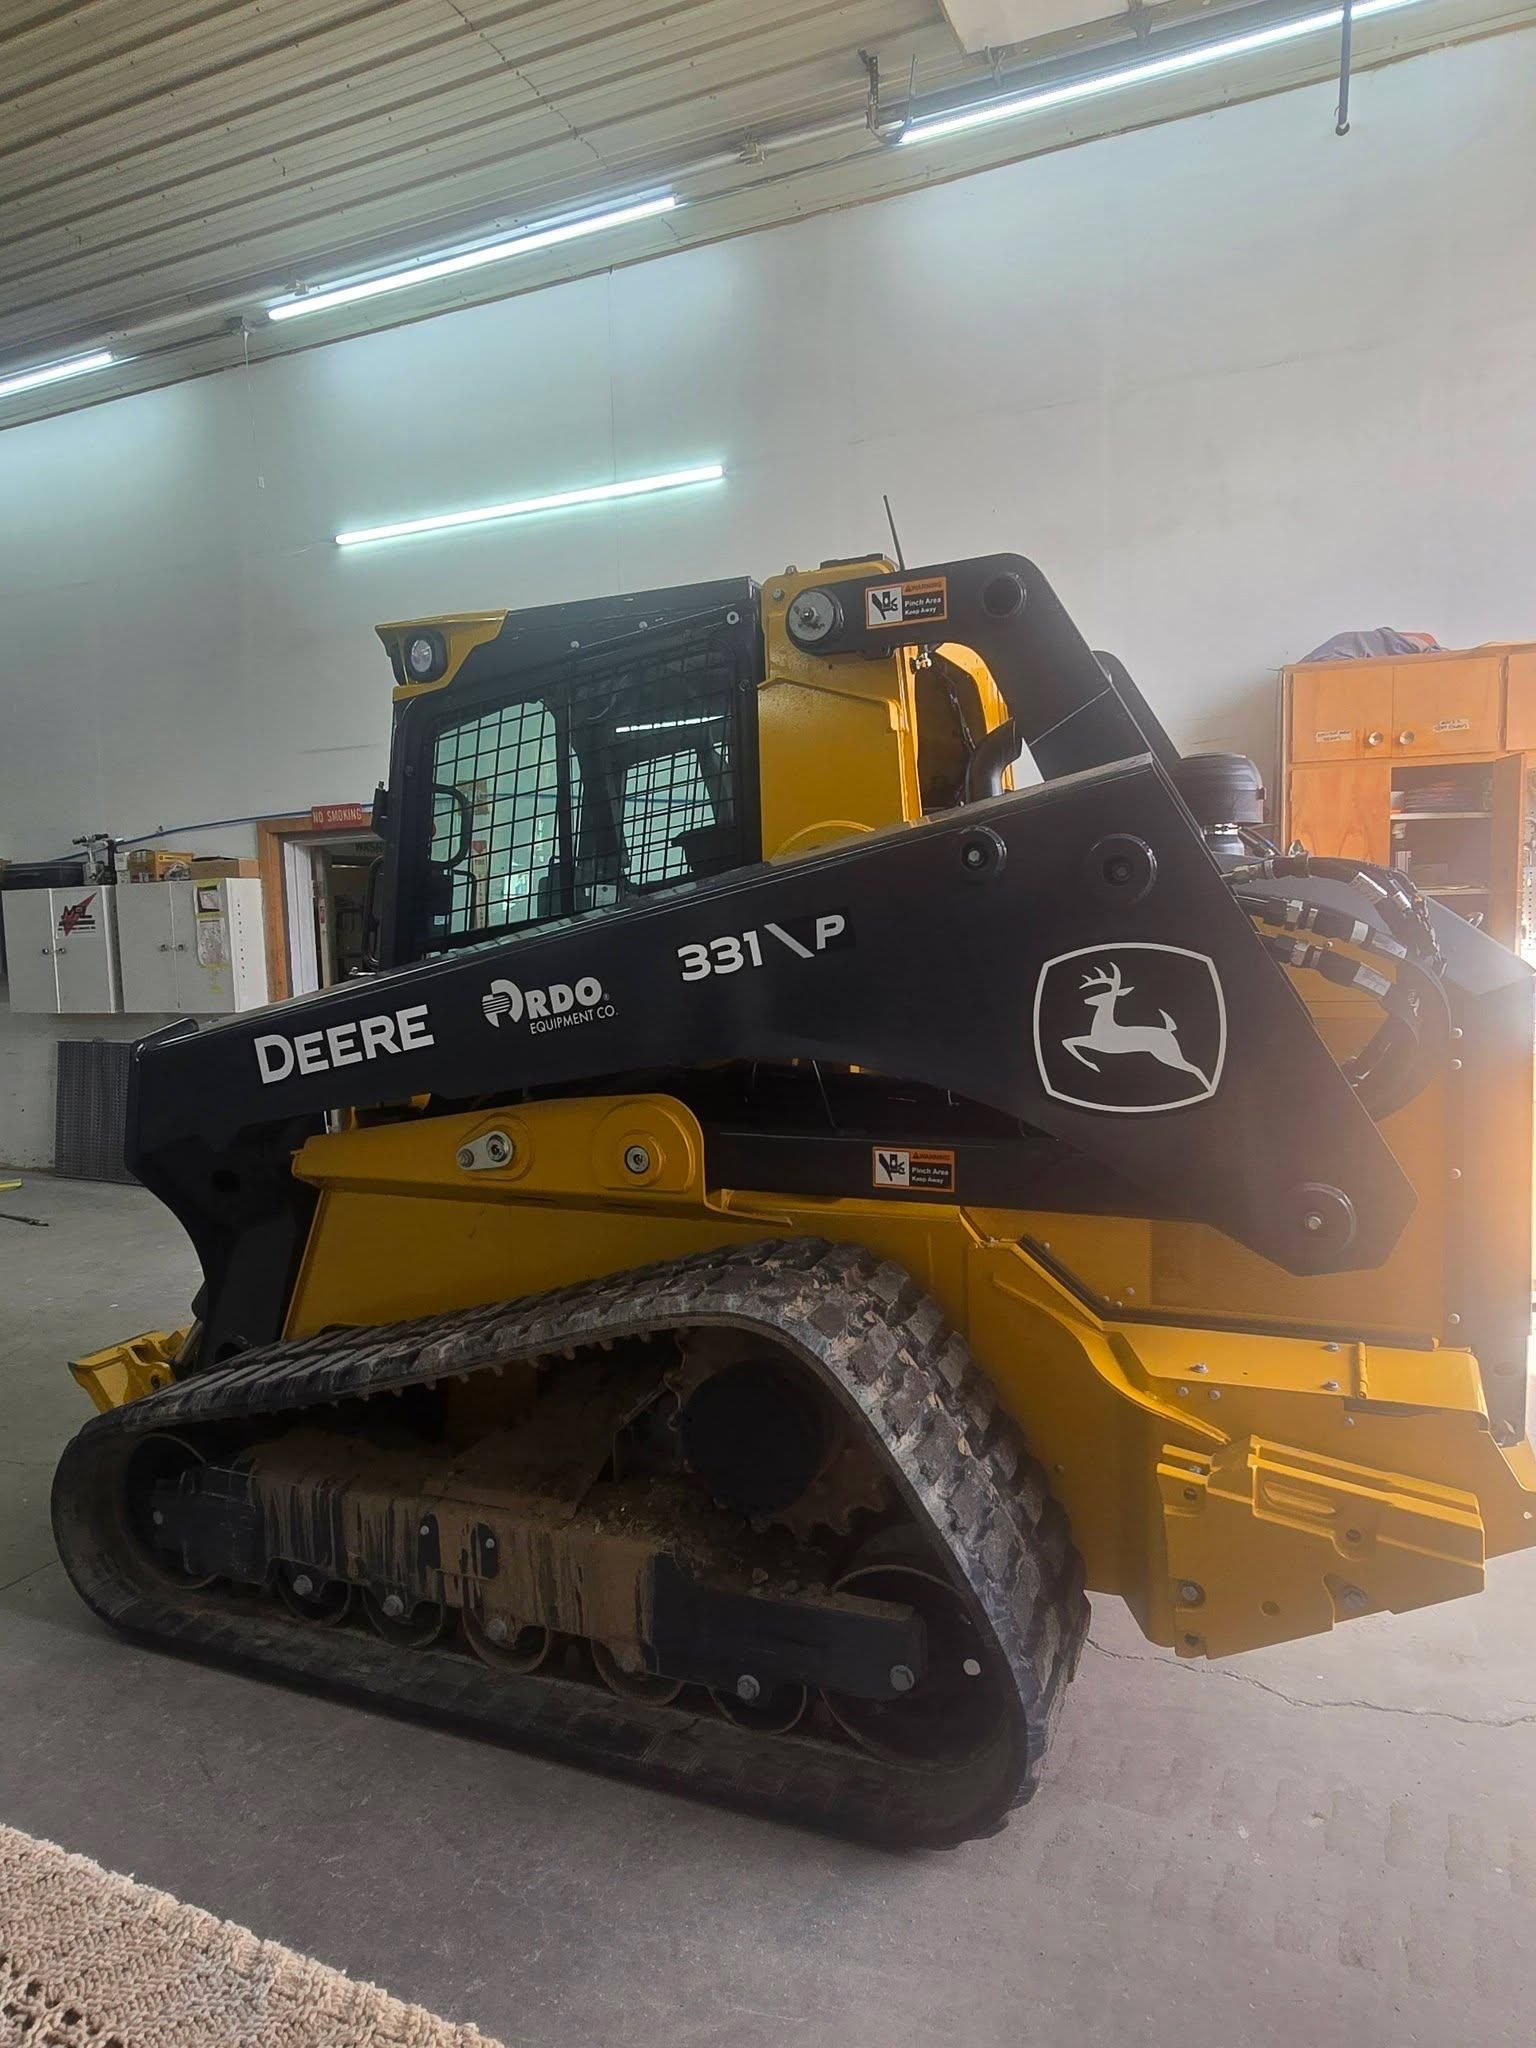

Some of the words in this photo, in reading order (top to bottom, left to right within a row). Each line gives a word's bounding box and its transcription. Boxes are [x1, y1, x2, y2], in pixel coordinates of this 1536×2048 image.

[904, 599, 924, 607] Pinch
[925, 597, 942, 605] Area
[920, 606, 936, 614] Away
[312, 810, 324, 824] NO
[326, 807, 362, 823] SMOKING
[677, 930, 763, 981] 331
[529, 1008, 594, 1035] EQUIPMENT
[596, 1004, 619, 1019] CO.
[253, 1004, 435, 1084] DEERE
[911, 1167, 931, 1175] Pinch
[932, 1168, 949, 1176] Area
